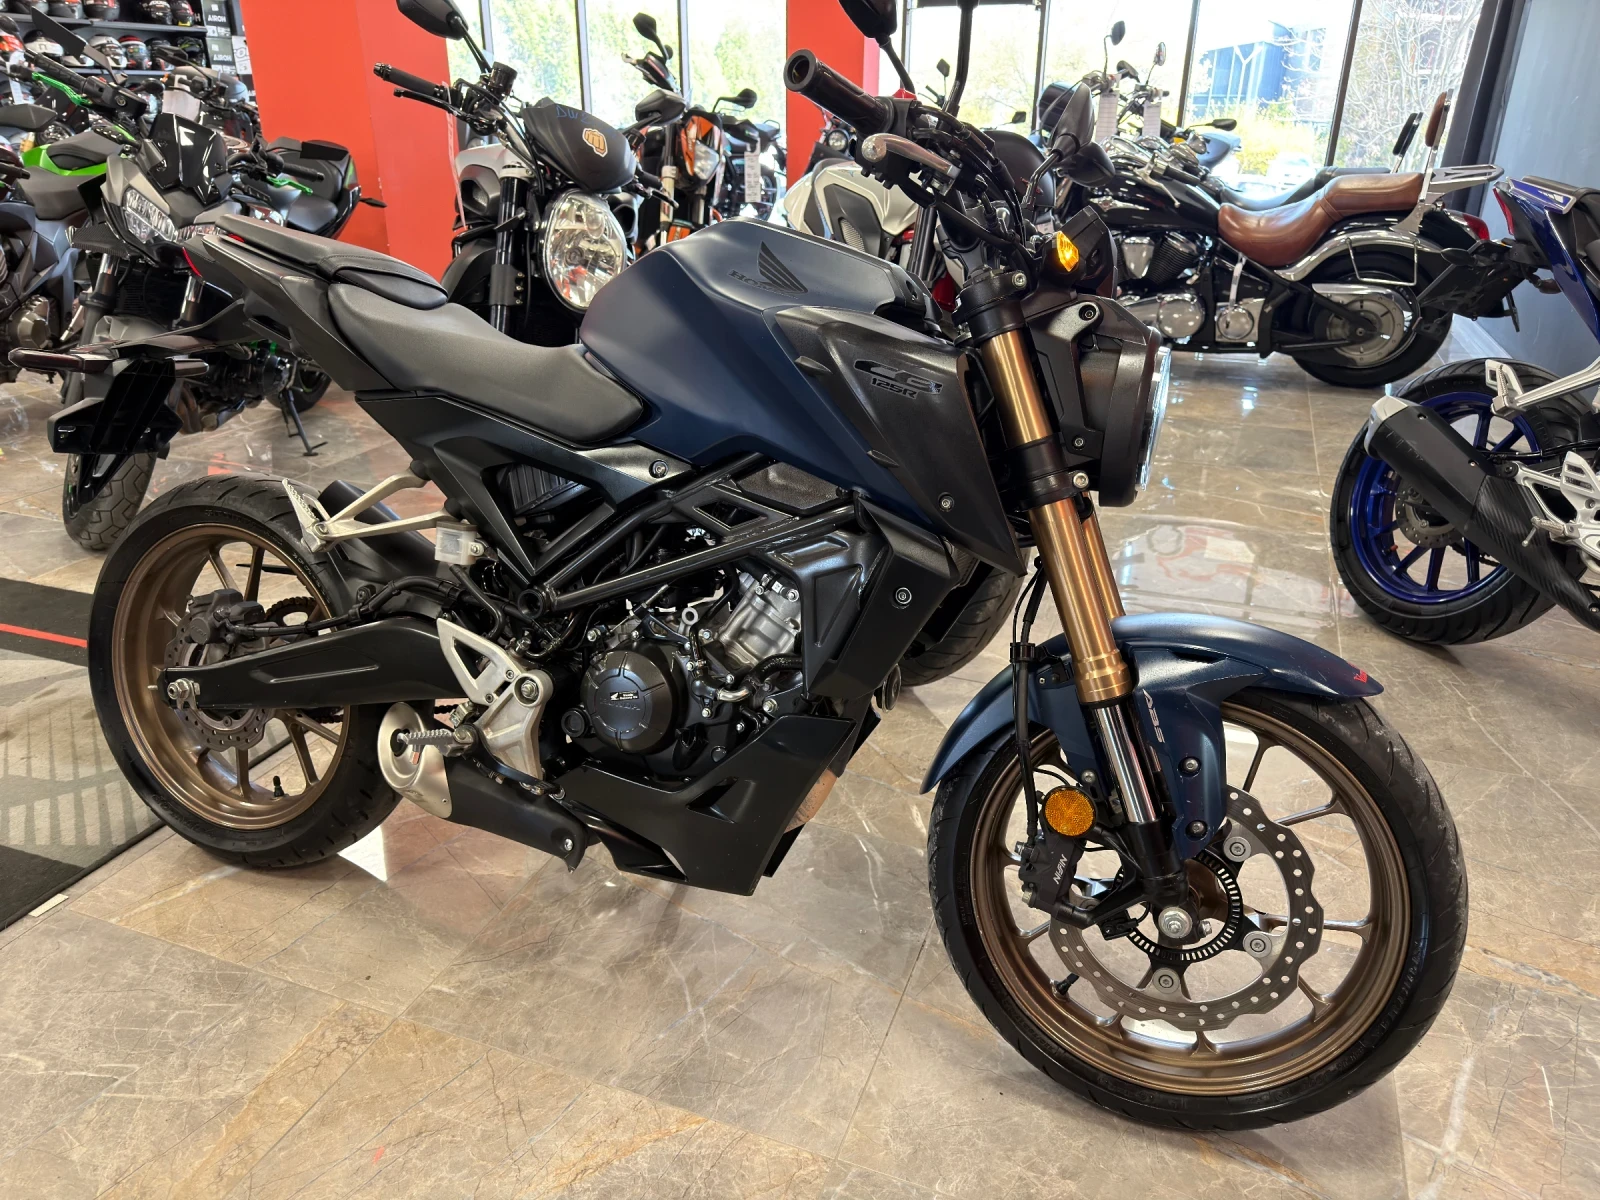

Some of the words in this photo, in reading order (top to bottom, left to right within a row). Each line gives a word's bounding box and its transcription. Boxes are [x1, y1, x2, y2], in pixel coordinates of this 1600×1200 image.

[207, 14, 227, 22] AIROH
[871, 377, 918, 399] 125R
[1142, 689, 1165, 743] ABS
